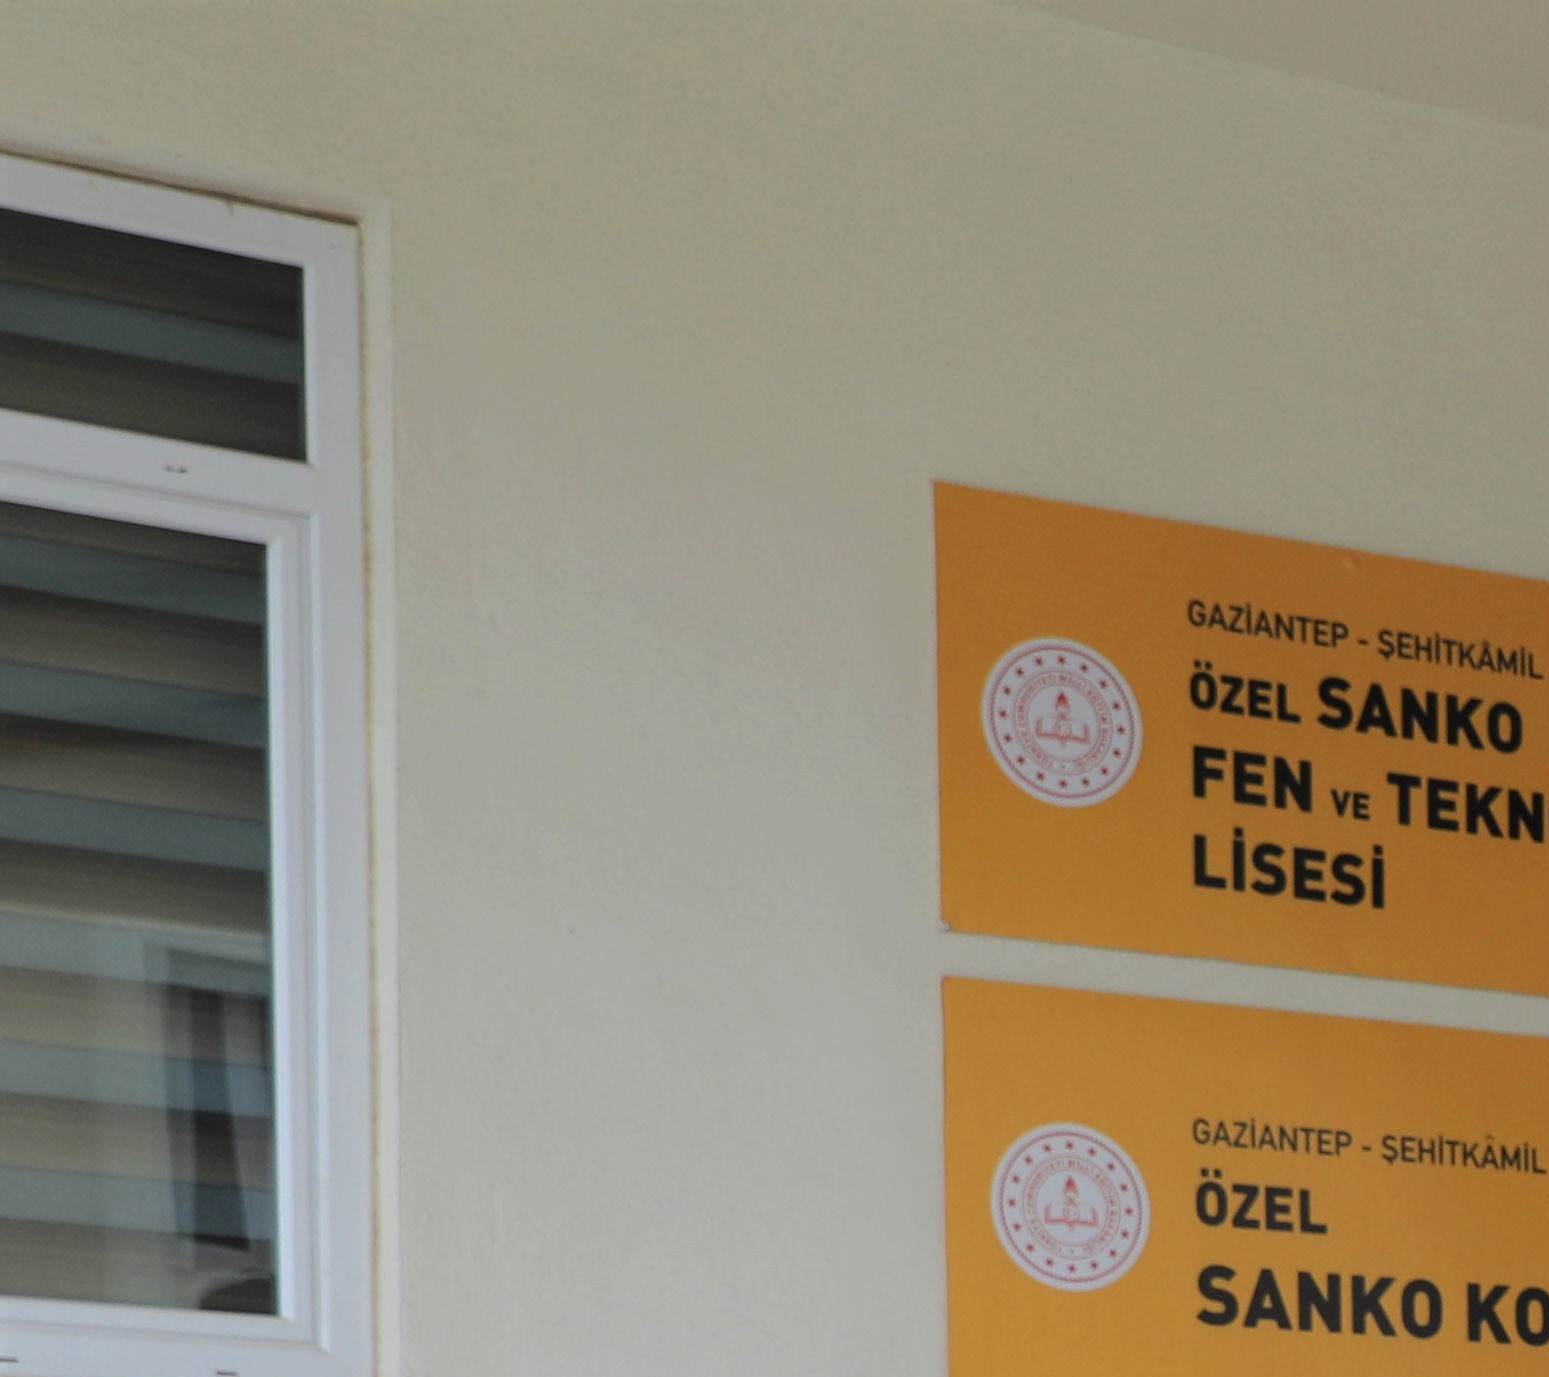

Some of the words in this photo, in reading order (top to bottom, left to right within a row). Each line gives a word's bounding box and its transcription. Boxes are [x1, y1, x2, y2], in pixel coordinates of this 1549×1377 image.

[1186, 597, 1349, 651] GAZİANTEP
[1377, 627, 1544, 682] ŞEHİTKÂMİL
[1188, 661, 1301, 724] ÖZEL
[1316, 675, 1524, 755] SANKO
[1192, 745, 1313, 812] FEN
[1330, 787, 1371, 821] VE
[1192, 826, 1387, 910] LİSESİ
[1191, 1116, 1353, 1158] GAZİANTEP
[1380, 1132, 1547, 1176] ŞEHİTKÂMİL
[1195, 1168, 1328, 1236] ÖZEL
[1196, 1264, 1443, 1341] SANKO
